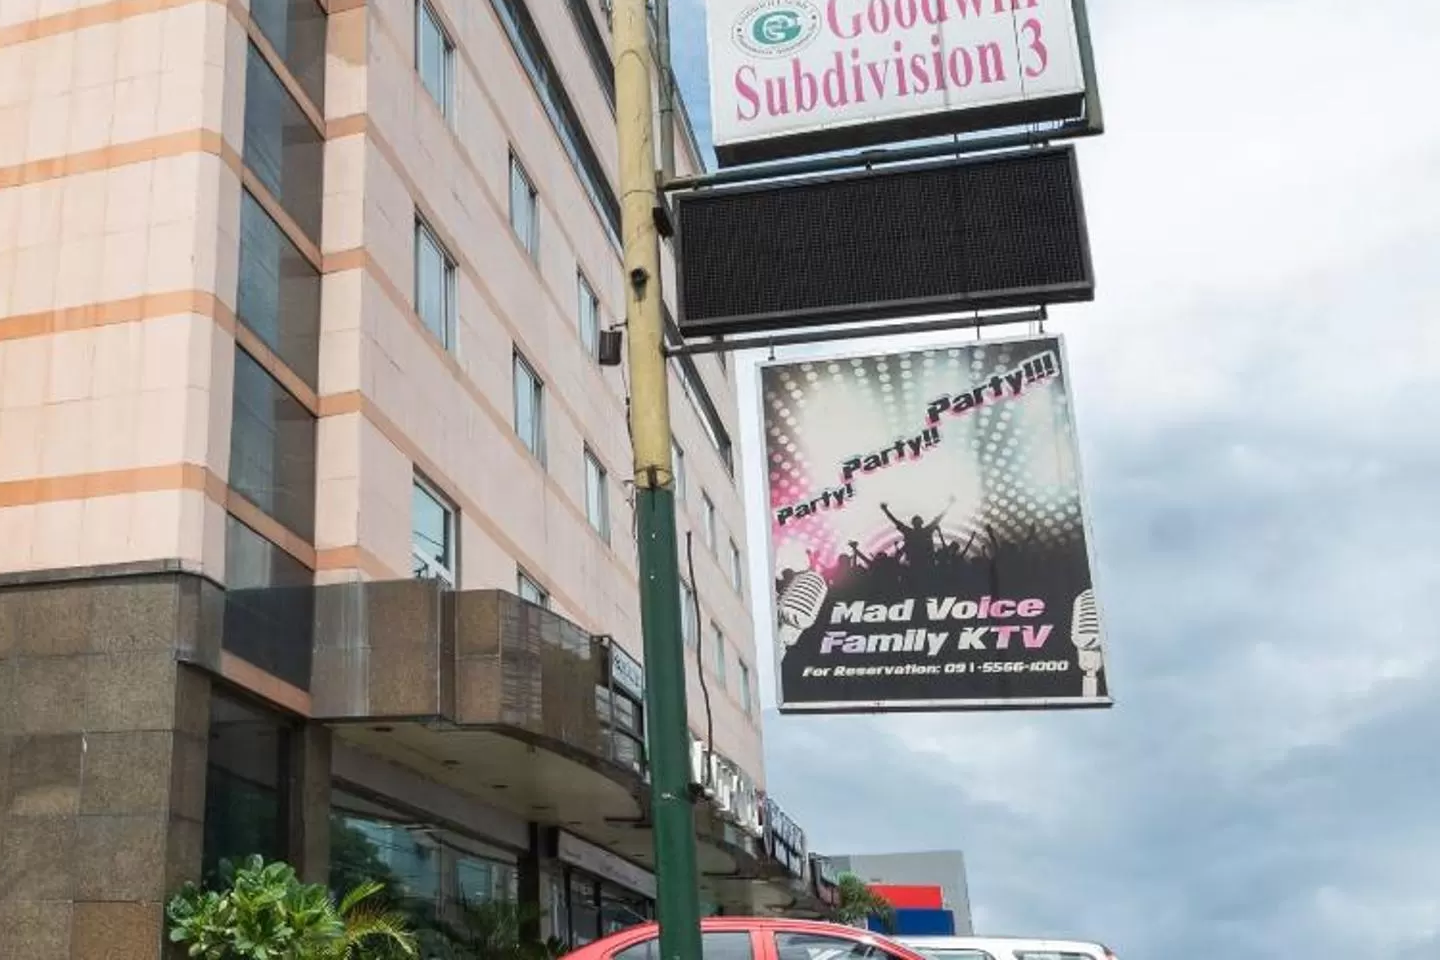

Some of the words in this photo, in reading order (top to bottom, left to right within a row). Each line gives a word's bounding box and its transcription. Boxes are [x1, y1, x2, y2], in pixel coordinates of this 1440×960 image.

[734, 34, 1007, 121] Subdivision
[1020, 19, 1049, 79] 3
[776, 483, 853, 526] Party!
[842, 426, 942, 481] Party!!
[927, 354, 1056, 424] Party!!!
[830, 598, 914, 625] Mad
[926, 595, 1045, 622] Voice
[819, 628, 948, 656] Family
[958, 624, 1053, 651] KTV
[801, 665, 832, 677] For
[833, 662, 942, 677] Reservation:
